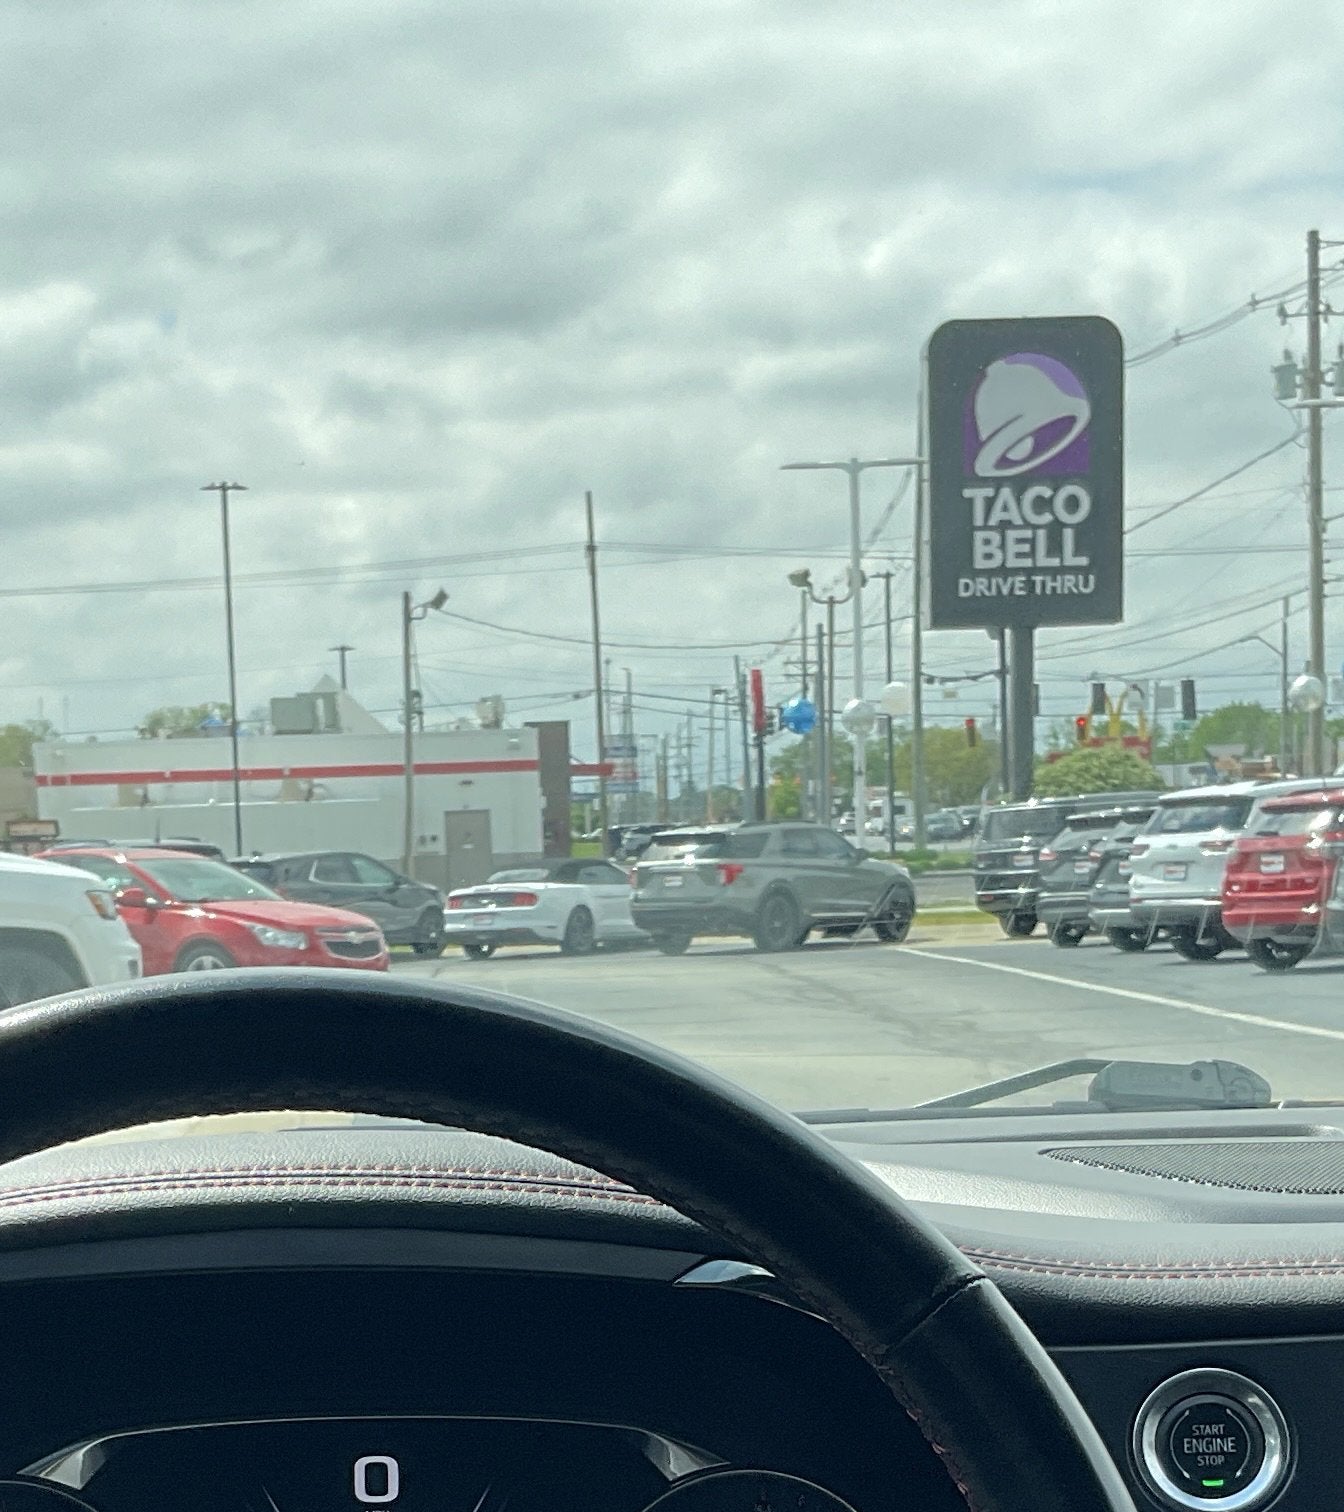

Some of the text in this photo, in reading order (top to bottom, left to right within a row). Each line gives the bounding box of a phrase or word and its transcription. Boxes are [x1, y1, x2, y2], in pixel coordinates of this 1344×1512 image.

[962, 484, 1091, 527] TACO
[973, 527, 1090, 570] BELL
[958, 574, 1095, 597] DRIVE THRU
[1192, 1423, 1225, 1436] START
[1183, 1436, 1236, 1454] ENGINE
[1196, 1454, 1225, 1467] STOP
[353, 1455, 400, 1504] 0
